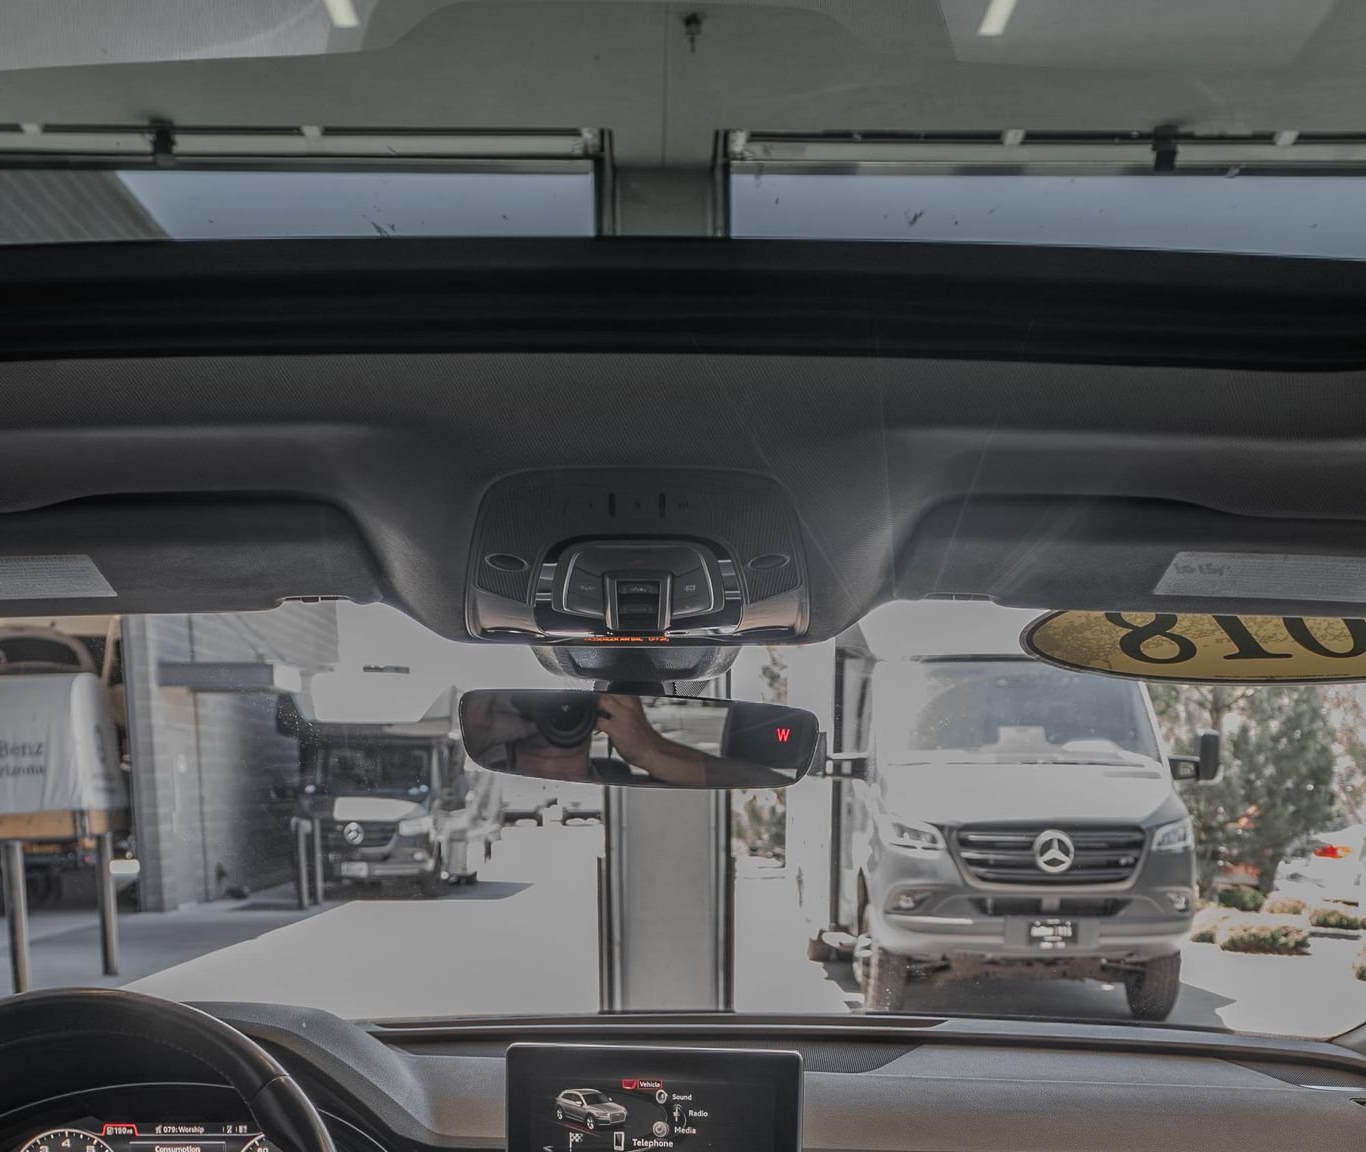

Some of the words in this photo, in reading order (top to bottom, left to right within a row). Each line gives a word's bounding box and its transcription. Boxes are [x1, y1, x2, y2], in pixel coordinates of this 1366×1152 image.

[776, 728, 790, 742] W
[672, 1093, 692, 1101] Sound
[688, 1109, 709, 1118] Radio
[179, 1126, 205, 1135] Worship
[674, 1126, 697, 1135] Media
[61, 1138, 71, 1148] 4
[632, 1138, 674, 1150] Telephone
